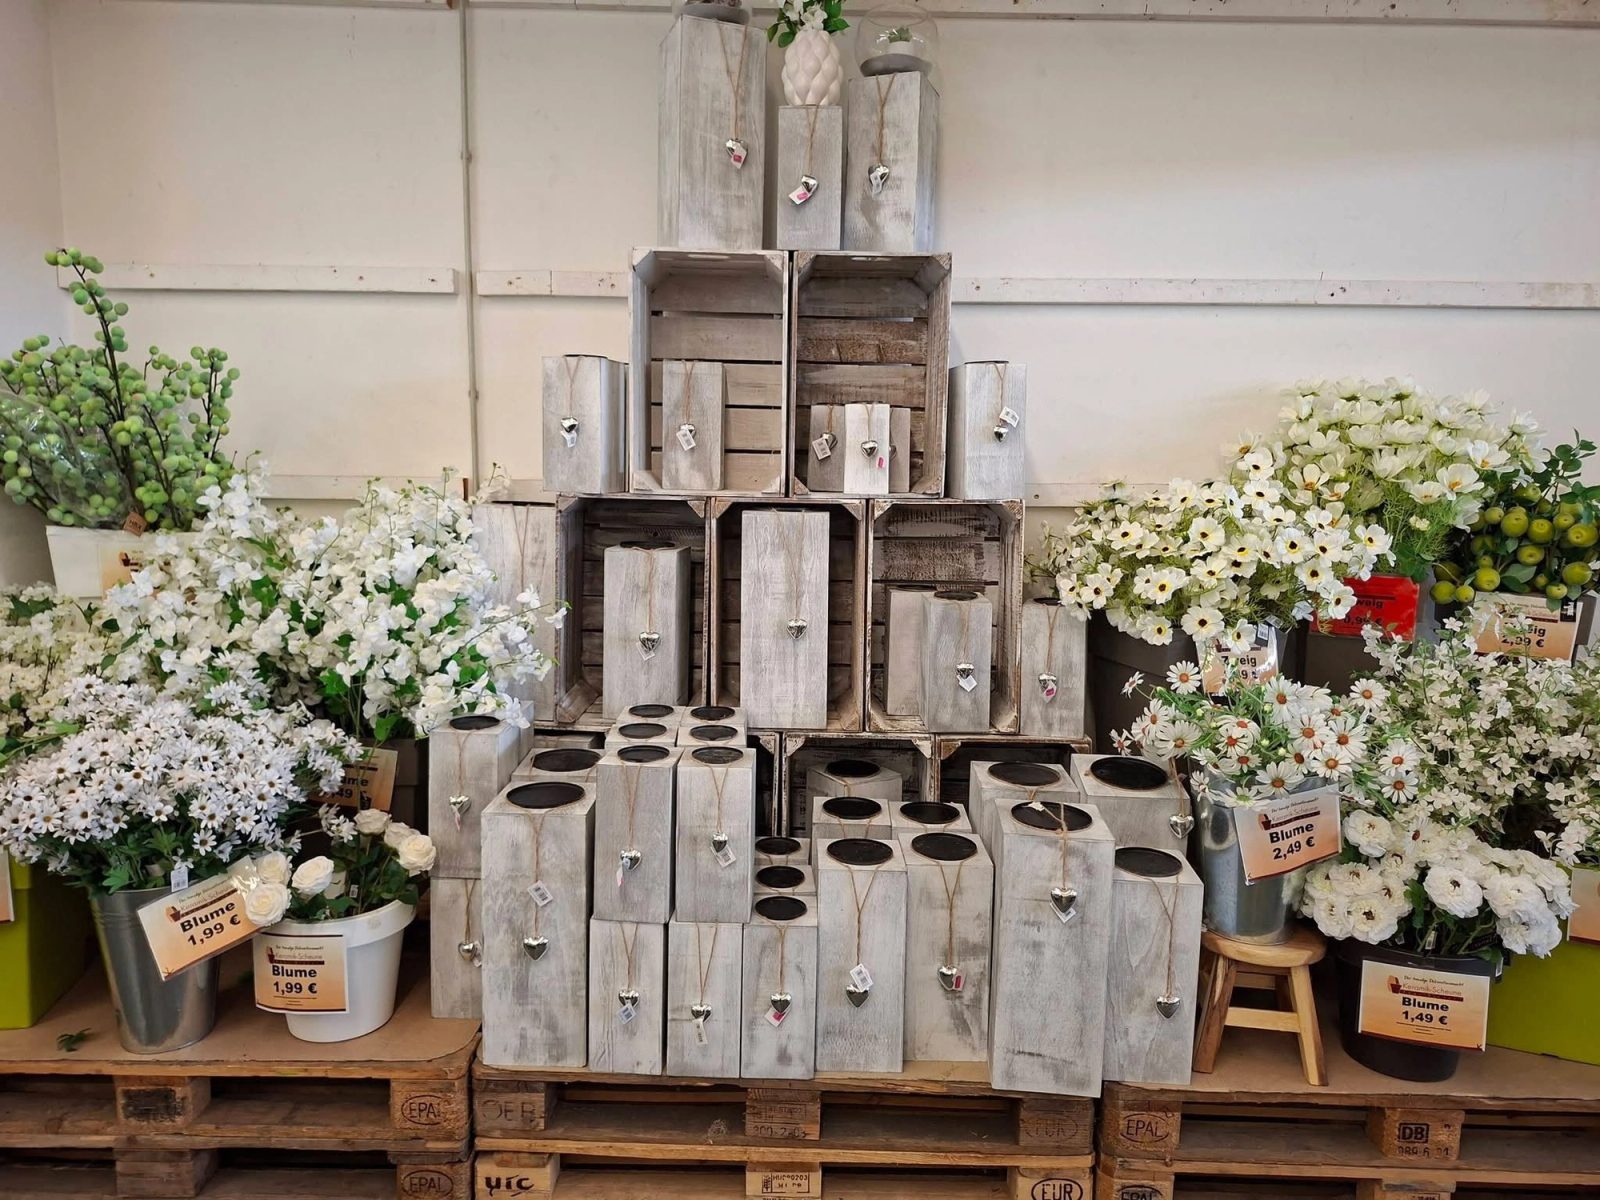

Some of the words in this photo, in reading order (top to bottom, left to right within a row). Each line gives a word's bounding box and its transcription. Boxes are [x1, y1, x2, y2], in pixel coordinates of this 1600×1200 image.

[1536, 638, 1545, 648] €
[1221, 655, 1257, 667] Zeig
[1269, 823, 1314, 844] Blume
[1272, 840, 1302, 860] 2,49
[1305, 836, 1315, 848] €
[180, 901, 236, 933] Blume
[187, 922, 225, 946] 1,99
[229, 914, 241, 926] €
[272, 964, 317, 978] Blume
[273, 981, 303, 996] 1,99
[307, 982, 318, 994] €
[1402, 996, 1450, 1012] Blume
[1402, 1010, 1434, 1024] 1,49
[1438, 1015, 1449, 1026] €
[1126, 1119, 1164, 1138] EPAL
[1401, 1126, 1425, 1141] DB
[409, 1173, 446, 1194] EPAL
[1041, 1183, 1074, 1200] EUR
